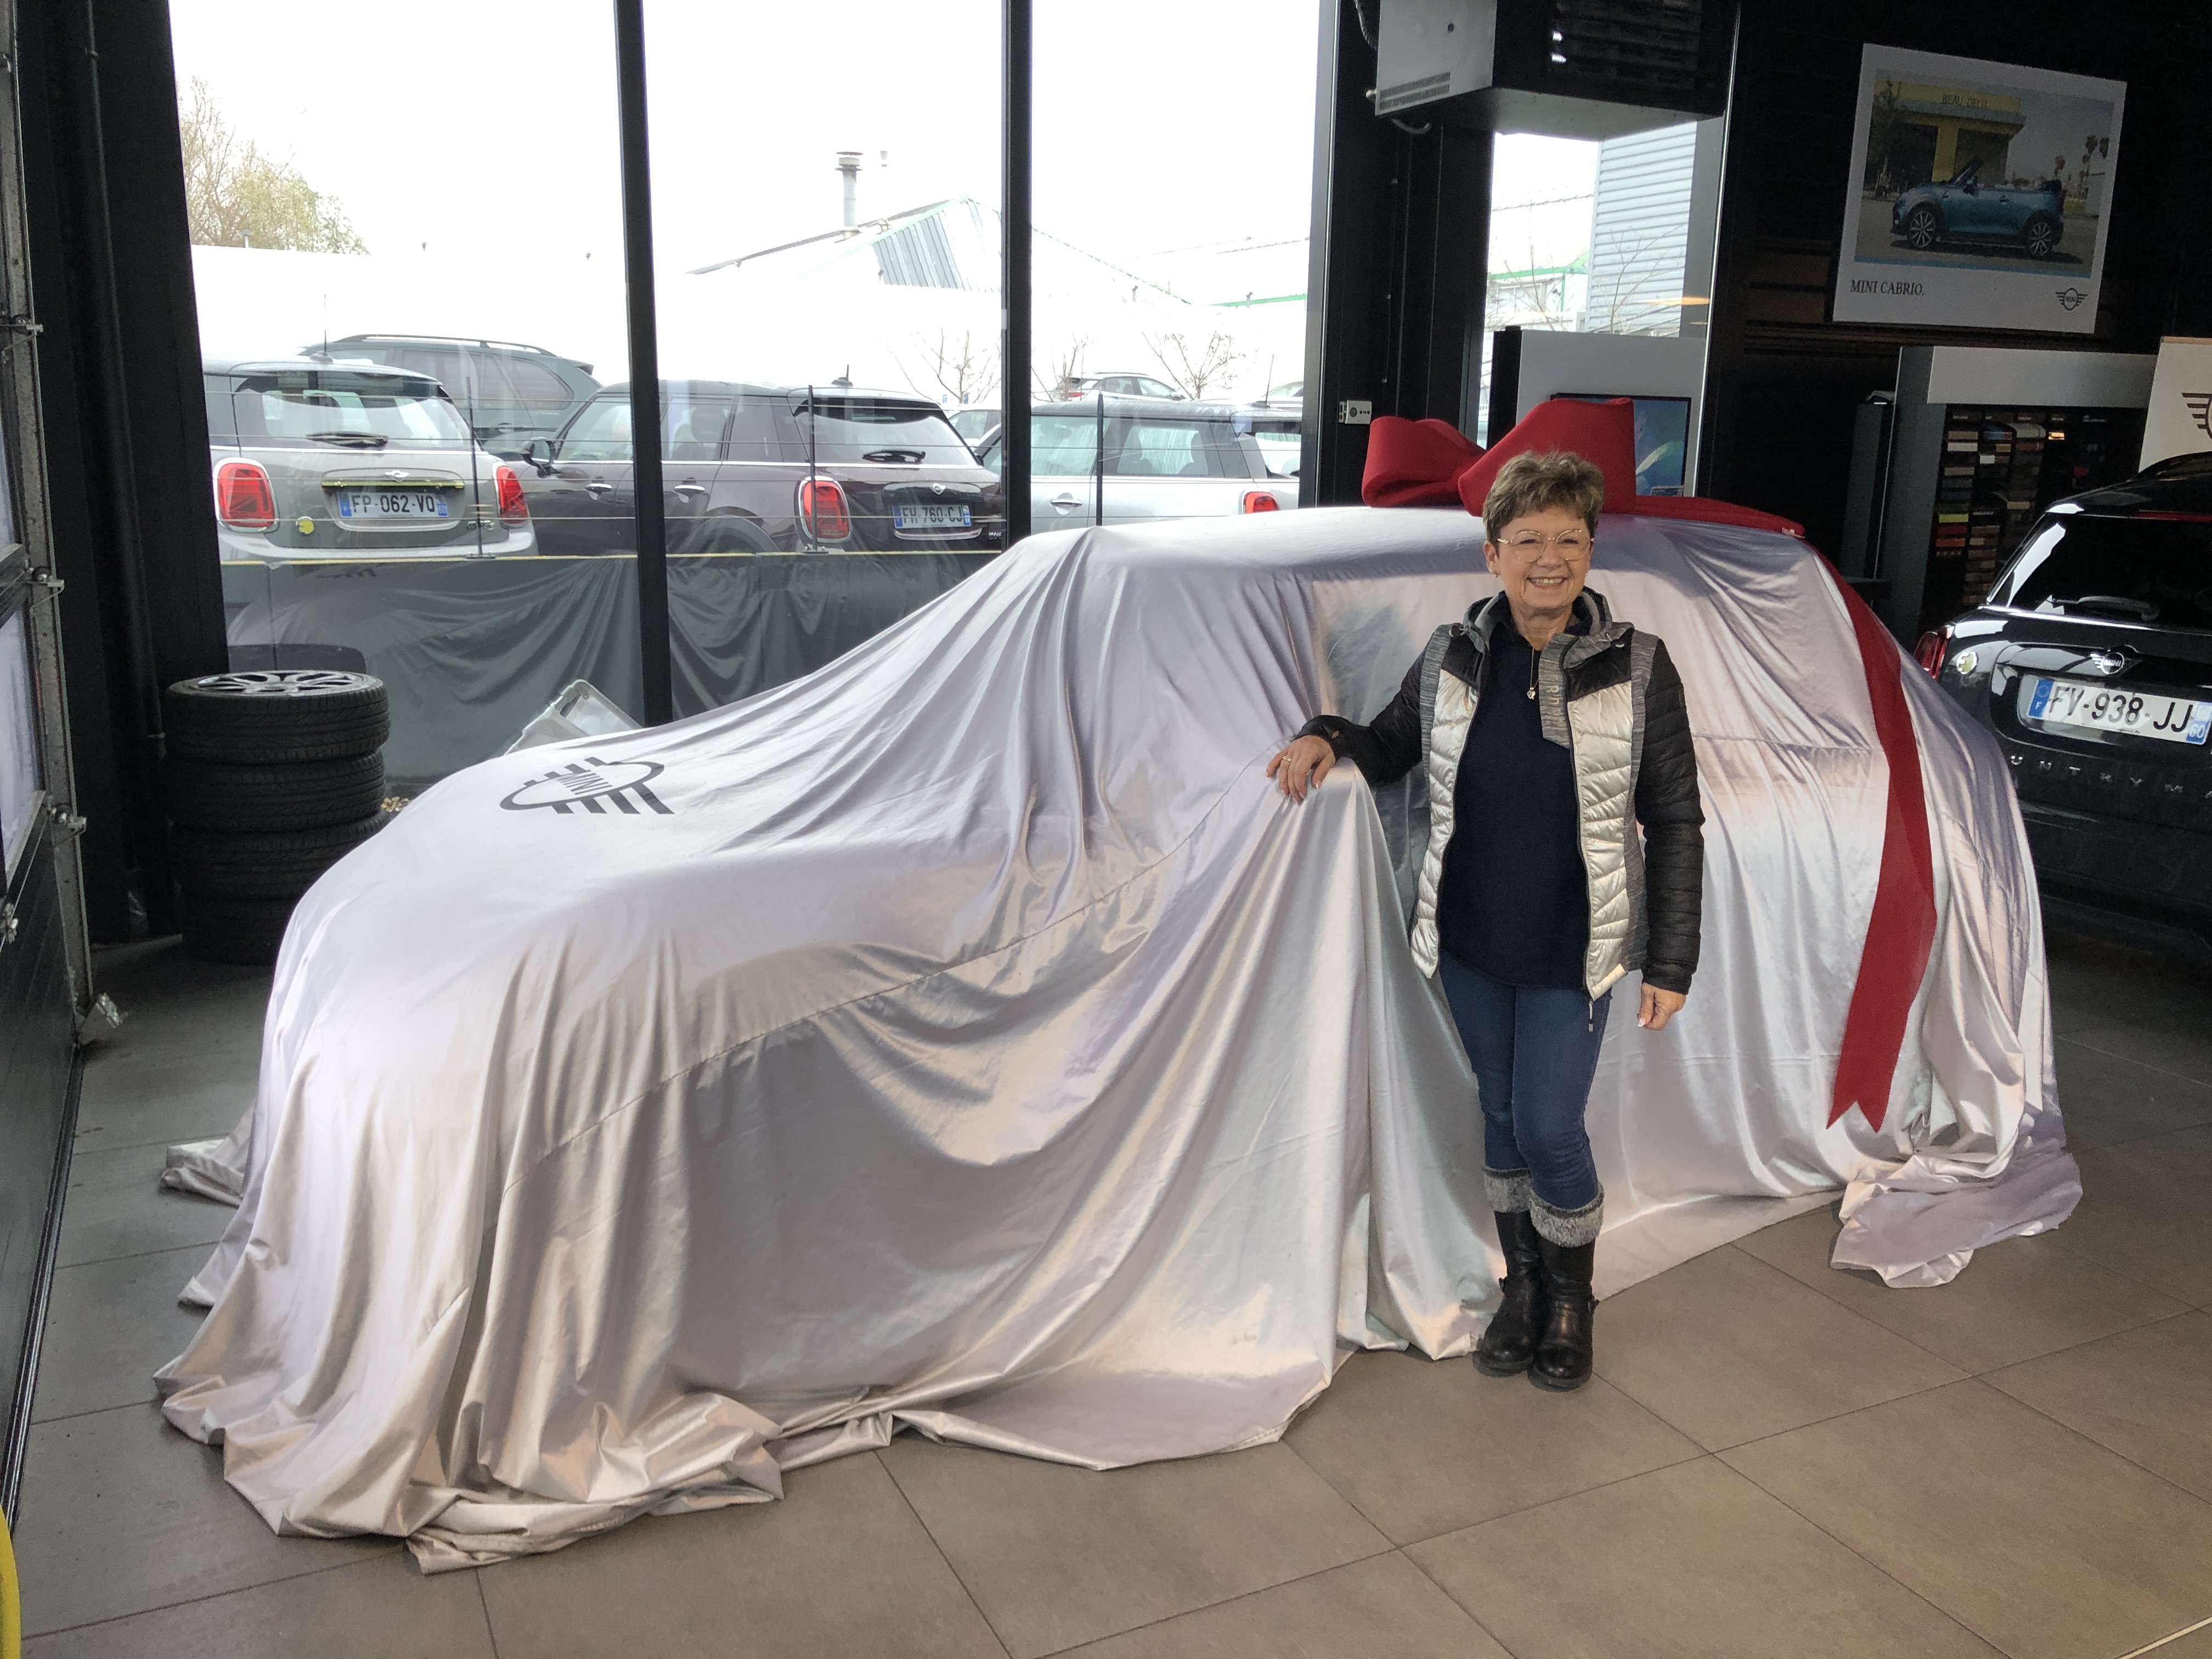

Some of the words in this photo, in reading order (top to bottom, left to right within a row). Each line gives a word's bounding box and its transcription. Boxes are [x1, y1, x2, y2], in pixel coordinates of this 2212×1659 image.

[1942, 93, 1963, 106] BEAU
[1850, 279, 1878, 294] MINI
[1880, 281, 1925, 296] CABRIO.
[2103, 658, 2122, 667] MINI
[2035, 701, 2042, 710] F
[2049, 685, 2194, 733] FV-938-JJ
[2189, 724, 2206, 739] 60
[555, 769, 613, 795] MINI
